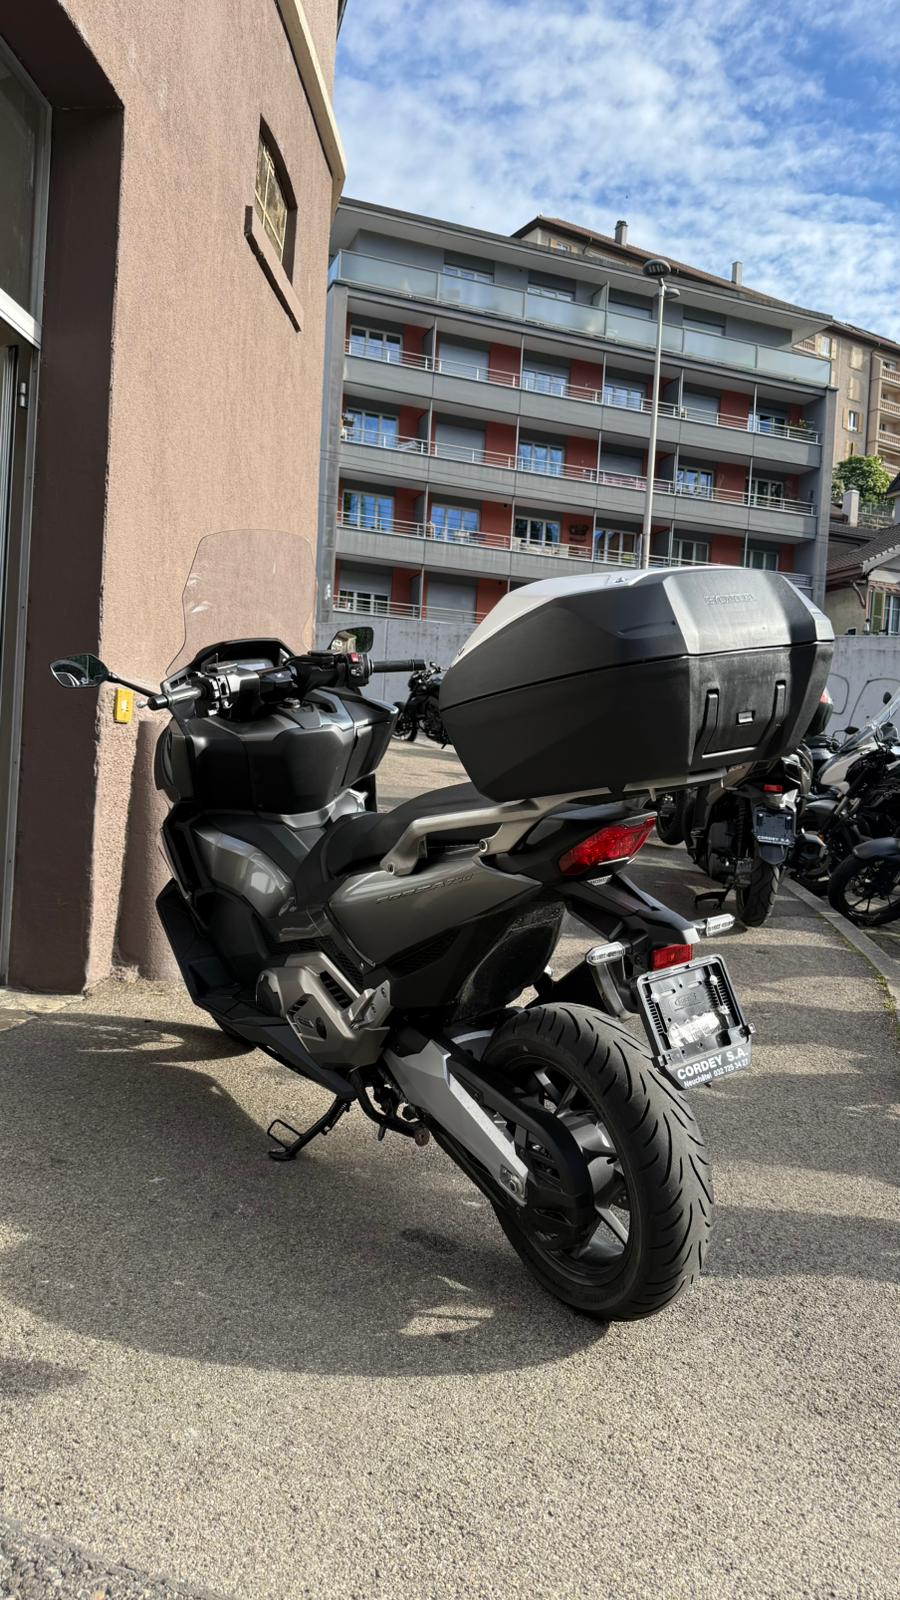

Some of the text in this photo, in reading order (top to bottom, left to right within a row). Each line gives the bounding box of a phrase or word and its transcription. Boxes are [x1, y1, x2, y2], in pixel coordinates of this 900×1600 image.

[677, 1047, 749, 1080] CORDEY S.A.
[683, 1072, 713, 1088] Neuchâtel
[713, 1067, 725, 1077] 032
[735, 1060, 743, 1070] 34
